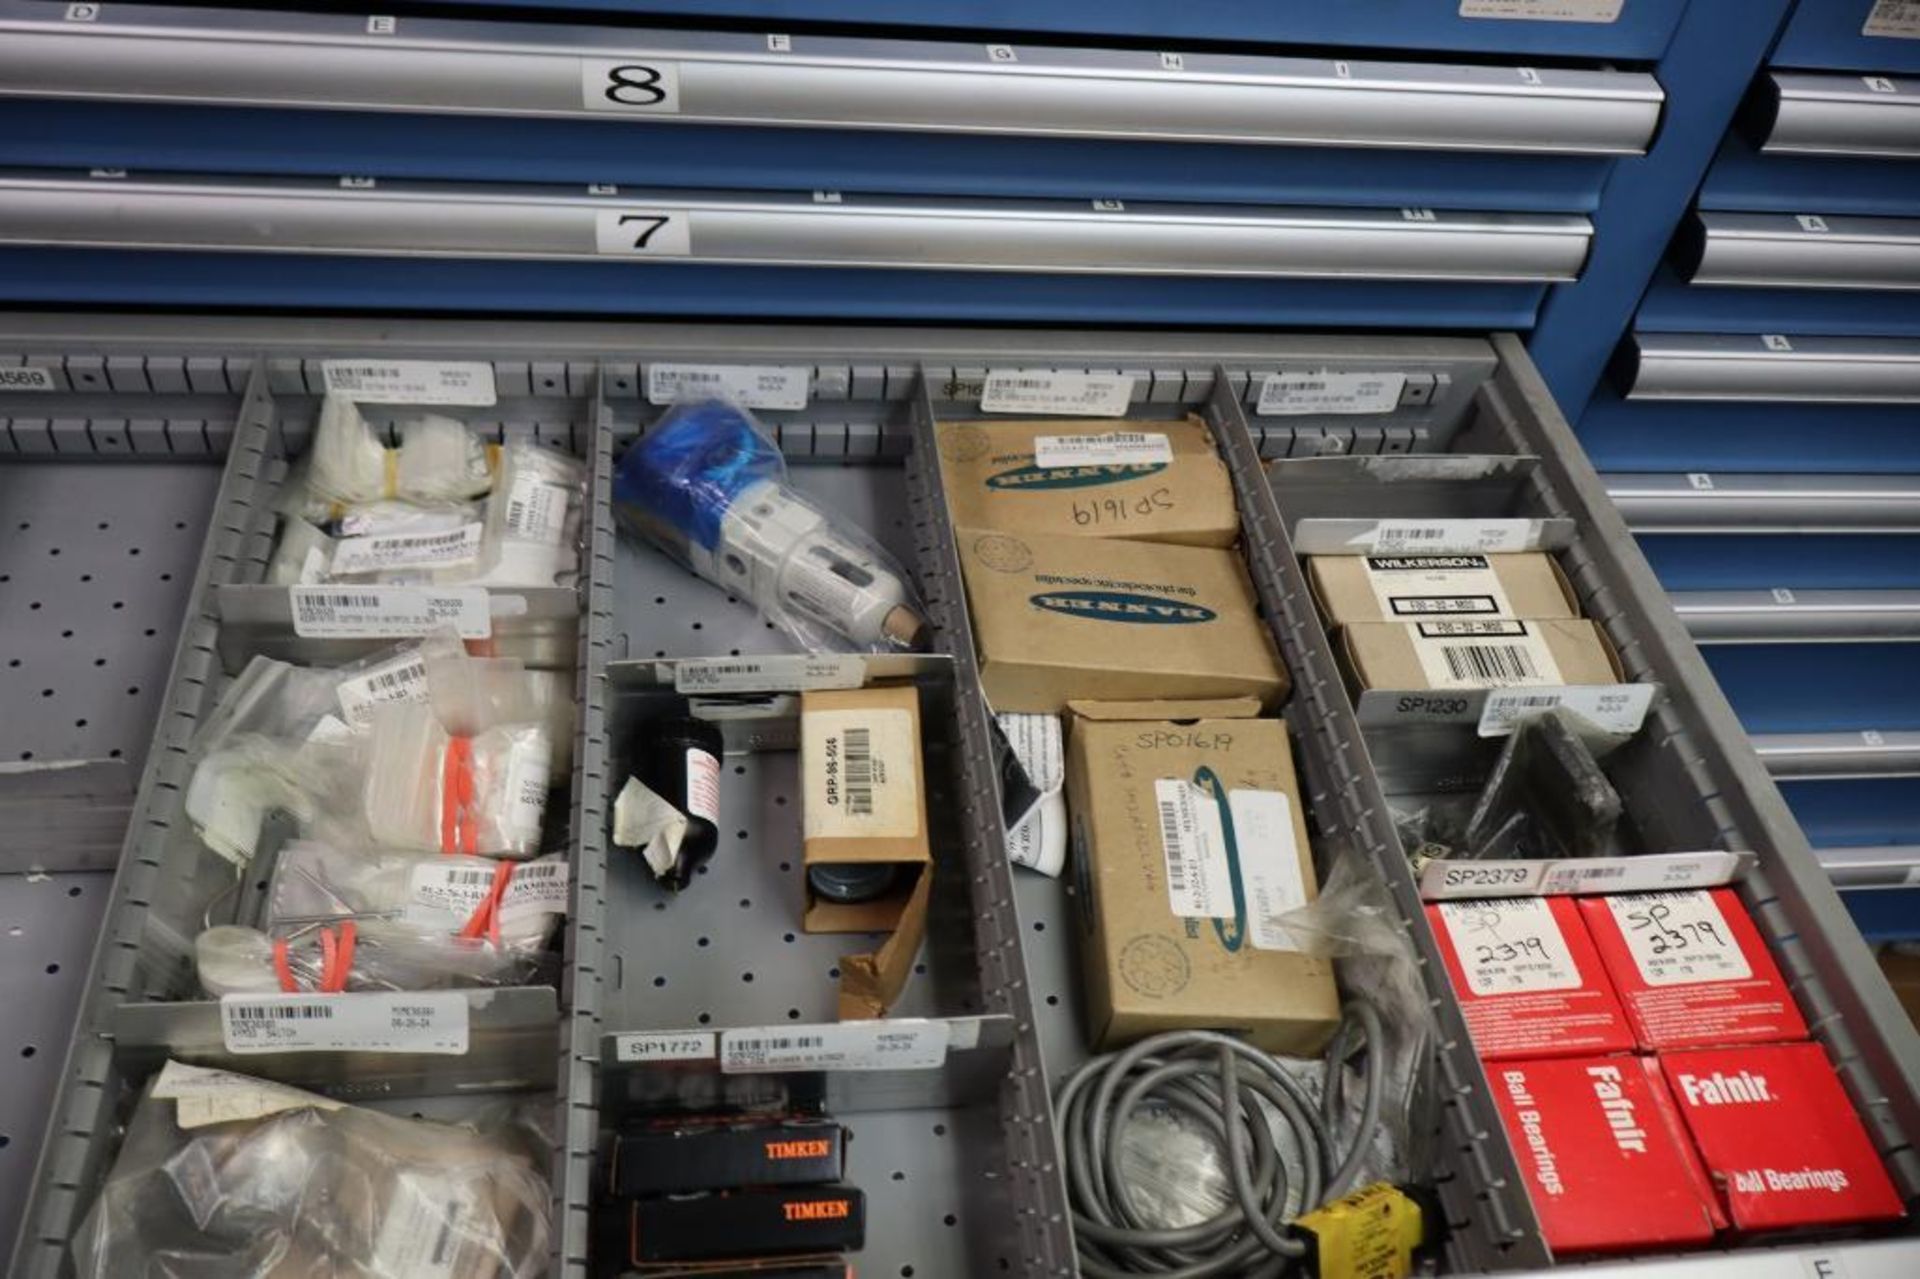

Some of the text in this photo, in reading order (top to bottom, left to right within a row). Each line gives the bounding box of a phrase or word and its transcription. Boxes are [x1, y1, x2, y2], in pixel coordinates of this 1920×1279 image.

[72, 5, 91, 19] D
[374, 18, 390, 31] E
[772, 36, 787, 48] F
[994, 48, 1011, 59] G
[1165, 57, 1180, 67] H
[605, 66, 666, 106] 8
[618, 215, 671, 249] 7
[1375, 557, 1478, 569] WILKERSON
[1041, 597, 1207, 619] BANNER
[1396, 696, 1468, 715] SP1230
[1446, 868, 1528, 886] SP2379
[1628, 904, 1671, 934] SP
[1650, 920, 1726, 953] 2379
[1476, 937, 1551, 963] 2379
[631, 1040, 702, 1055] SP1772
[1679, 1071, 1771, 1106] Fafnir
[1587, 1066, 1647, 1155] Fafnir
[1503, 1070, 1564, 1195] Ball Bearings
[766, 1140, 830, 1159] TIMKEN
[1763, 1166, 1849, 1192] Bearings
[783, 1200, 850, 1221] TIMKEN
